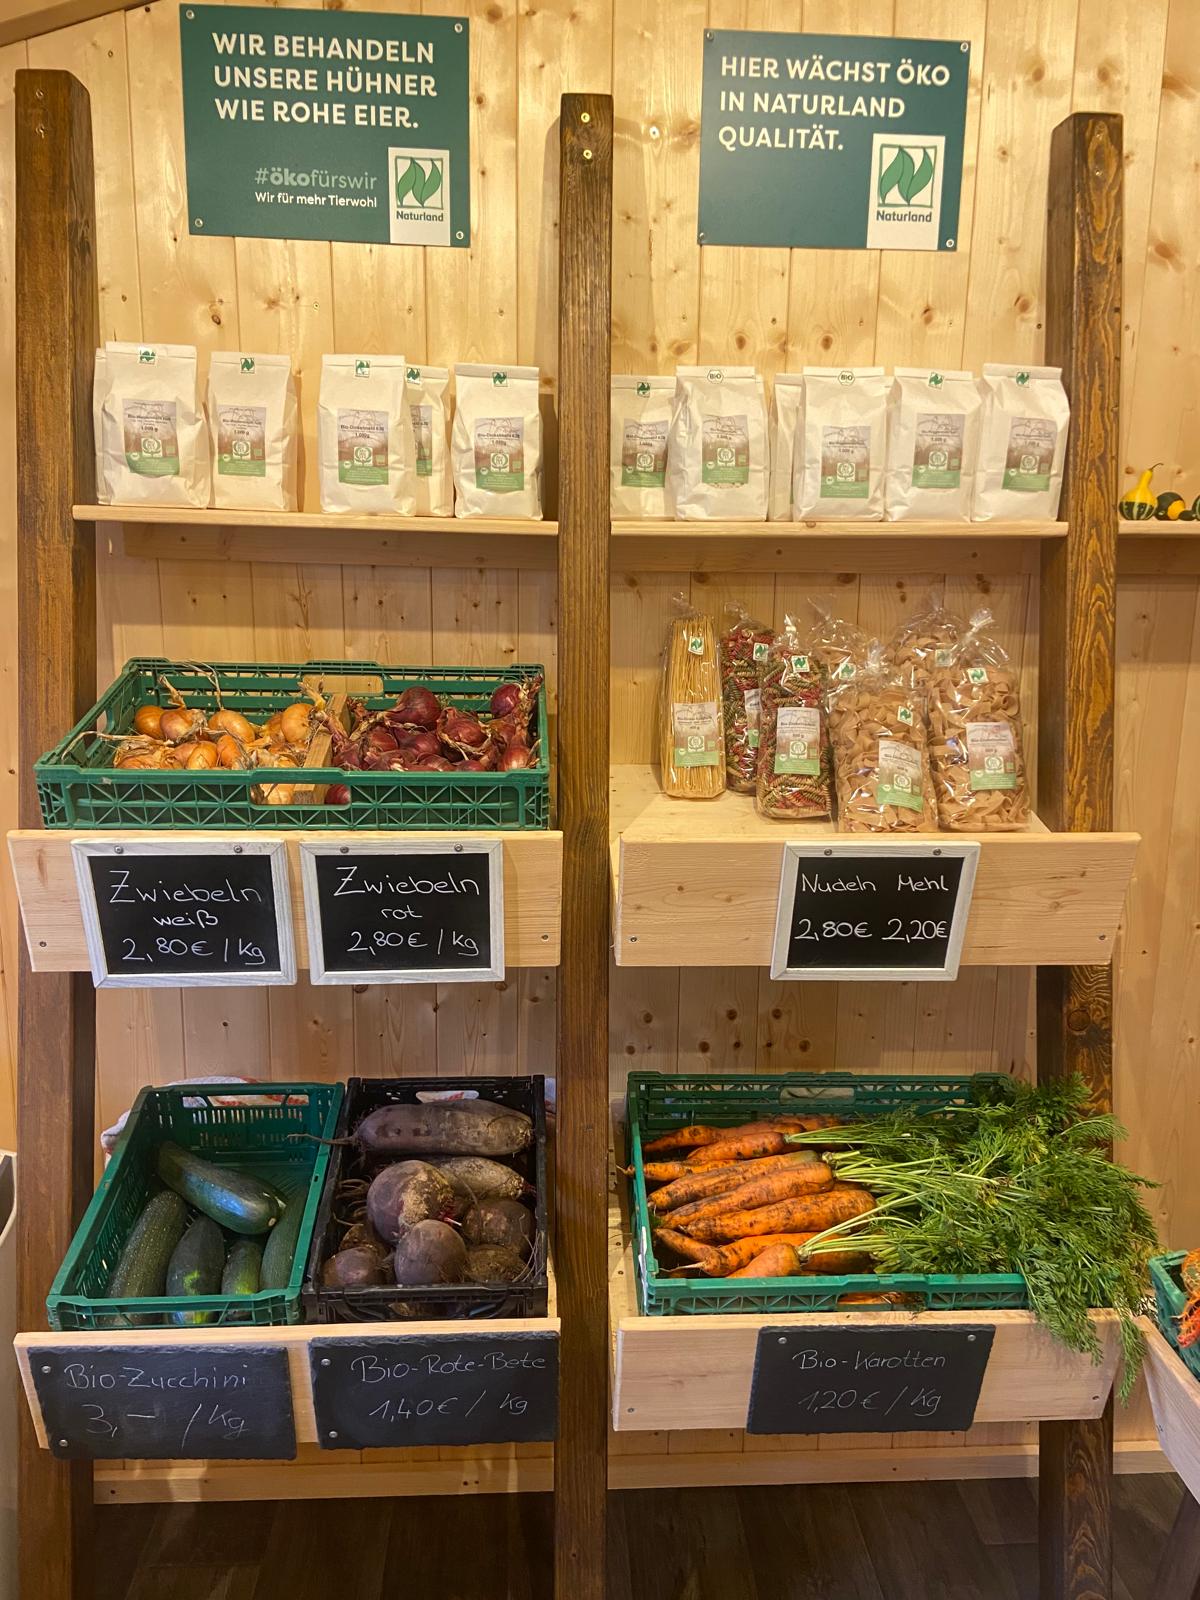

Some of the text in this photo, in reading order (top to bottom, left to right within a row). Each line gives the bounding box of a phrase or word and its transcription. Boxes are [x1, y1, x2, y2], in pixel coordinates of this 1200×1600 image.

[212, 32, 434, 64] WIR BEHANDELN
[214, 65, 437, 97] UNSERE HÜHNER
[721, 54, 950, 87] HIER WÄCHST ÖKO
[214, 98, 419, 129] WIE ROHE EIER.
[720, 91, 905, 118] IN NATURLAND
[718, 123, 844, 151] QUALITÄT.
[254, 167, 377, 190] #ökofürswir
[255, 191, 377, 208] Wir für mehr Tierwohl
[396, 210, 444, 222] Naturland
[876, 210, 932, 223] Naturland
[109, 870, 262, 903] Zwiebeln
[333, 866, 480, 896] Zwiebeln
[801, 873, 949, 894] Nudeln Mehl
[153, 910, 219, 929] weiß
[381, 905, 423, 919] rot
[347, 931, 428, 956] 2,80€
[794, 918, 948, 944] 2,80€ 2,20€
[122, 938, 214, 962] 2,80€
[64, 1362, 248, 1389] Bio-Zucchini
[351, 1351, 546, 1384] Bio-Rote-Bete
[369, 1397, 458, 1423] 1,40€
[798, 1389, 880, 1415] 1,20€
